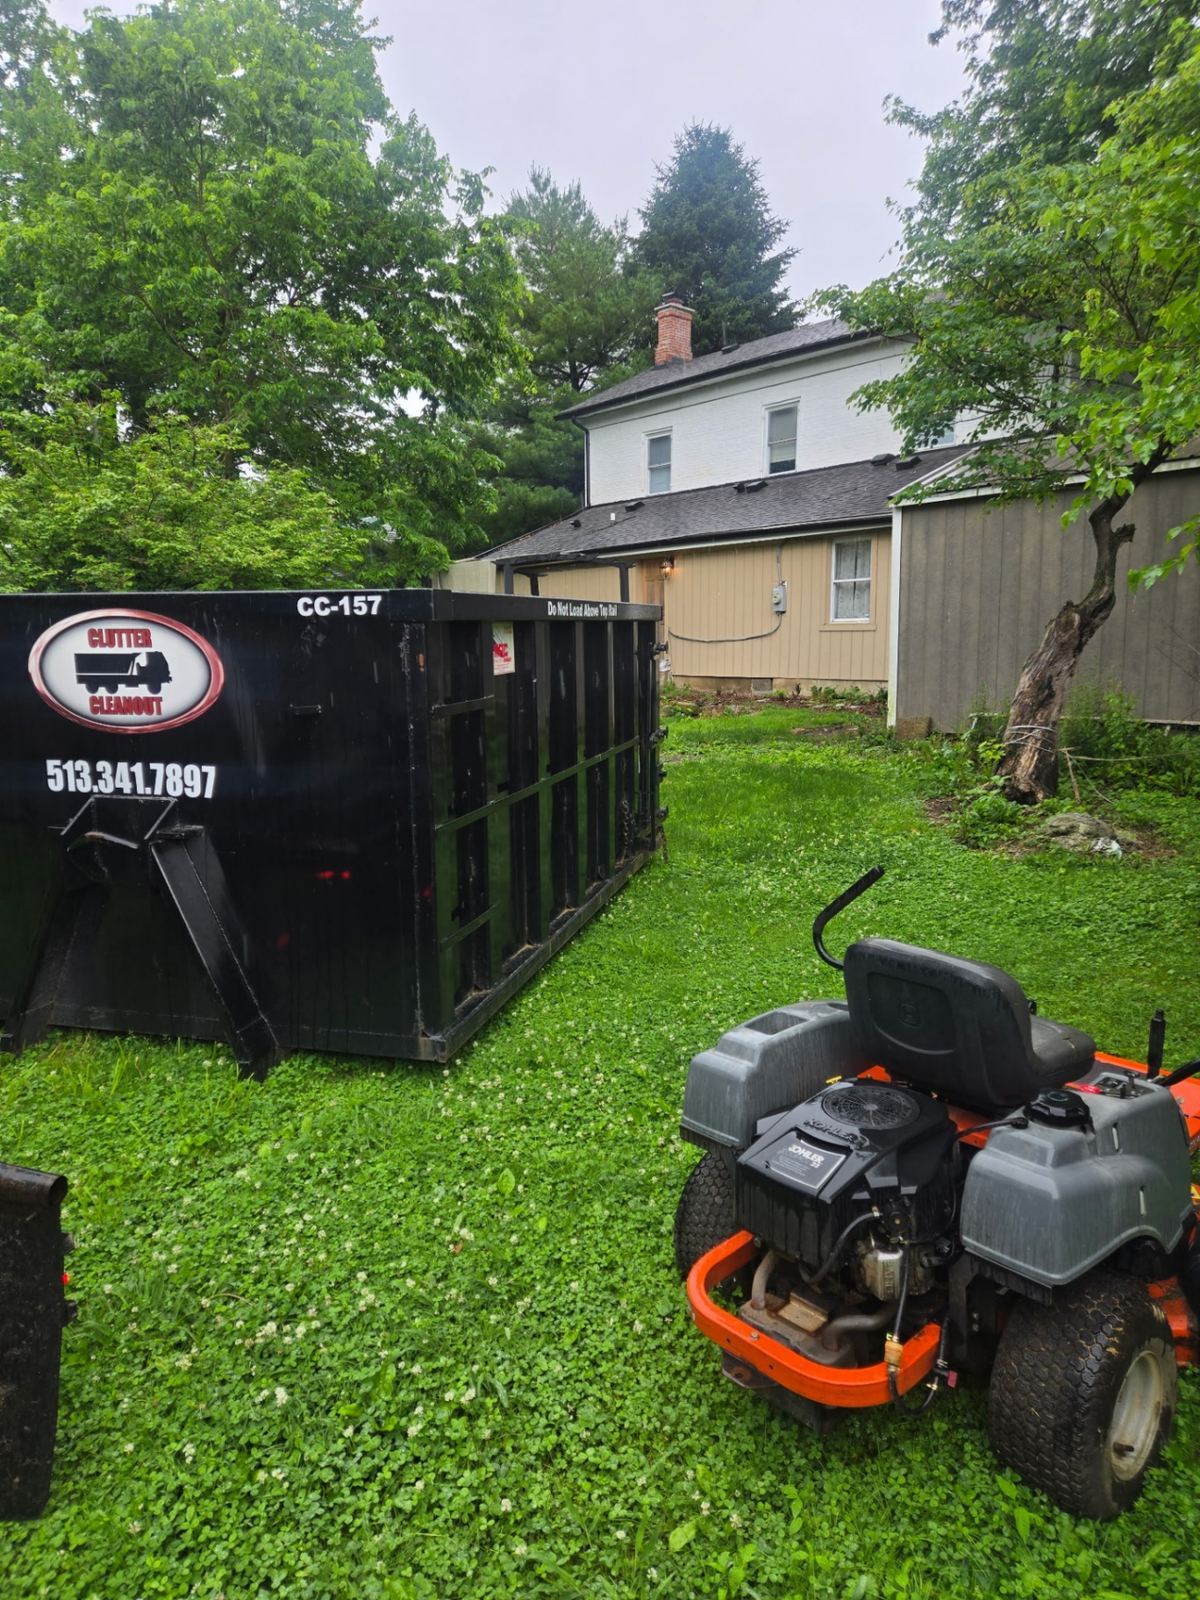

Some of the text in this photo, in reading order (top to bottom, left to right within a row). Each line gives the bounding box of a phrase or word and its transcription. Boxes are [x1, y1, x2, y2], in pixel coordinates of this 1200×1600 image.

[296, 595, 382, 617] CC-157
[547, 601, 557, 616] Do
[557, 602, 569, 617] Not
[569, 602, 583, 617] Load
[583, 603, 599, 617] Above
[608, 604, 618, 617] Rail
[88, 628, 152, 648] CLUTTER
[89, 696, 162, 715] CLEANOUT
[46, 759, 216, 799] 513.341.7897
